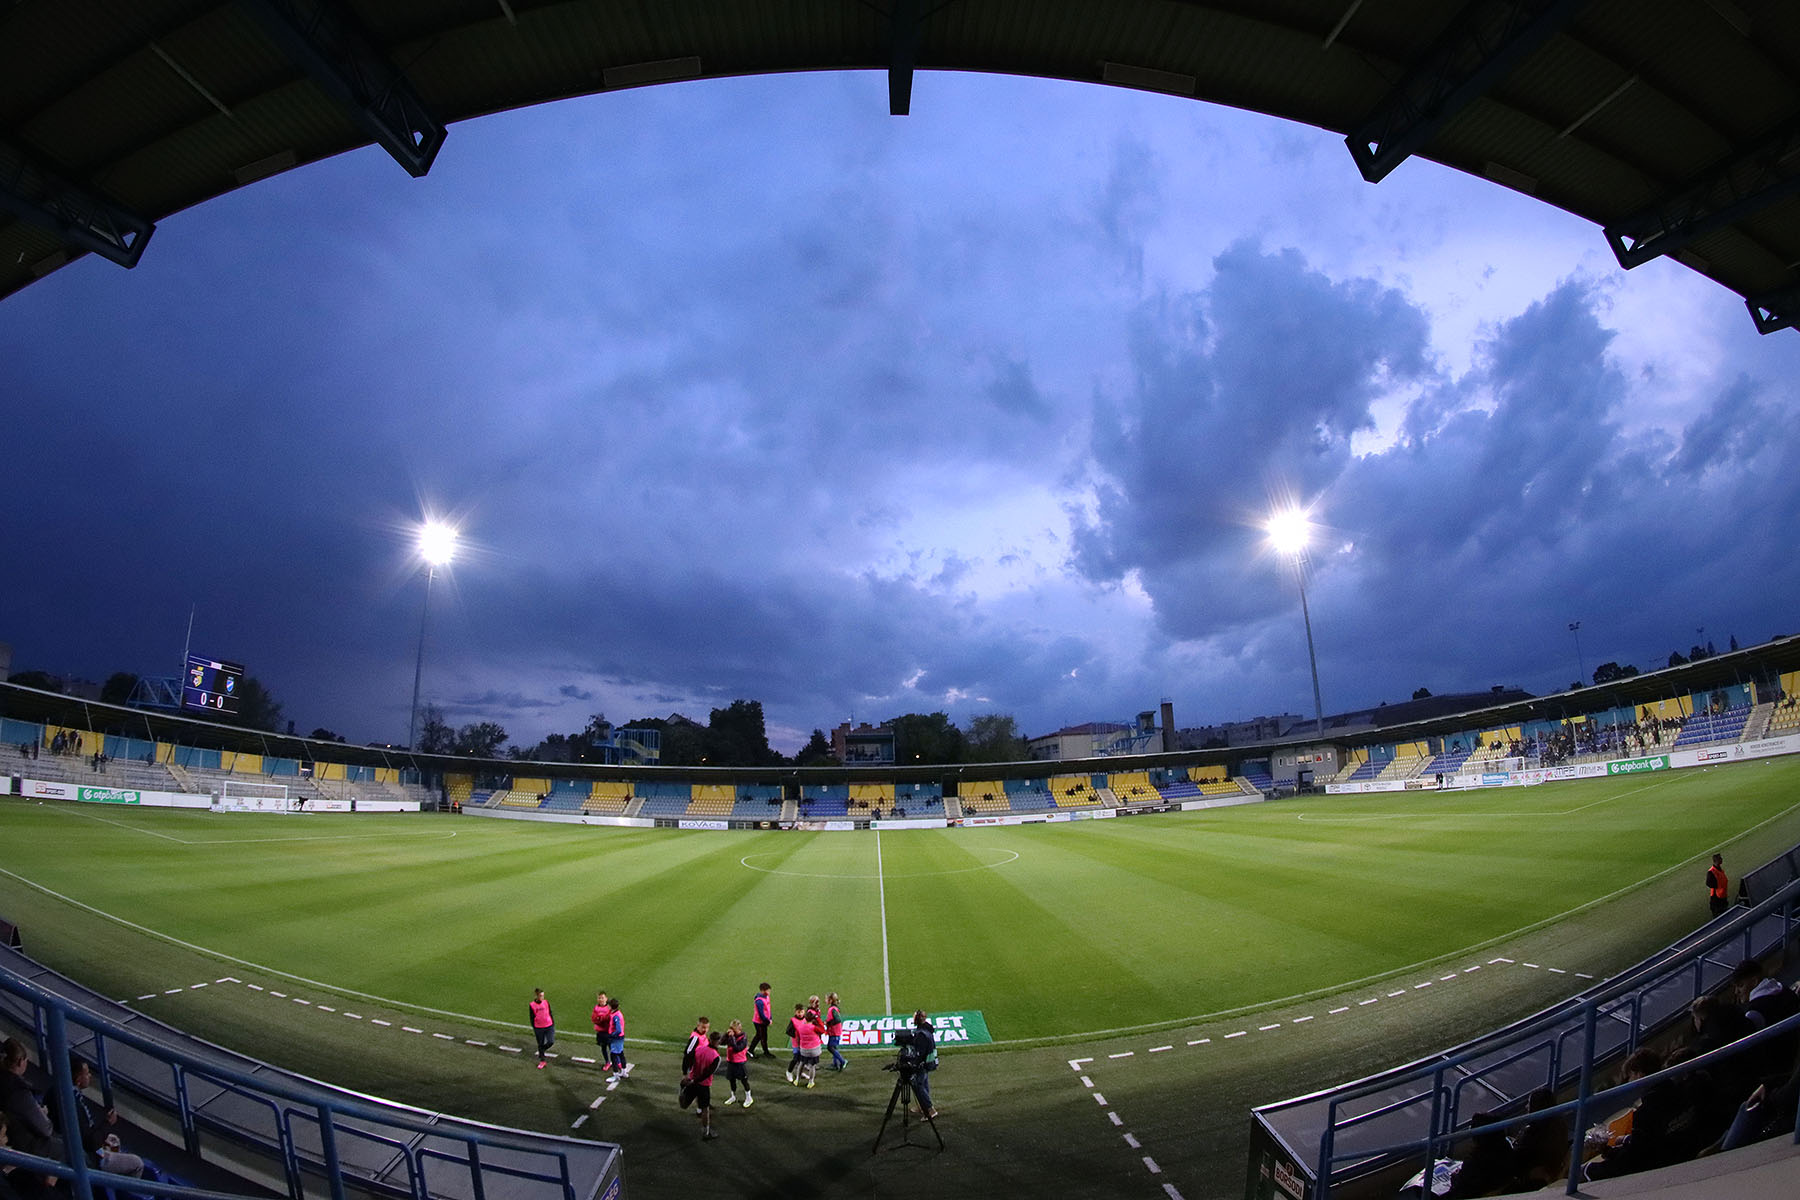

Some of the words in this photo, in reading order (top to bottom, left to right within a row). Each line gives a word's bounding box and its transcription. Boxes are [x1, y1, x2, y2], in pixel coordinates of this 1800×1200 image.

[201, 692, 207, 705] 0
[217, 696, 223, 708] 0
[1620, 760, 1650, 772] otpbank
[1276, 1167, 1303, 1198] BORSODI
